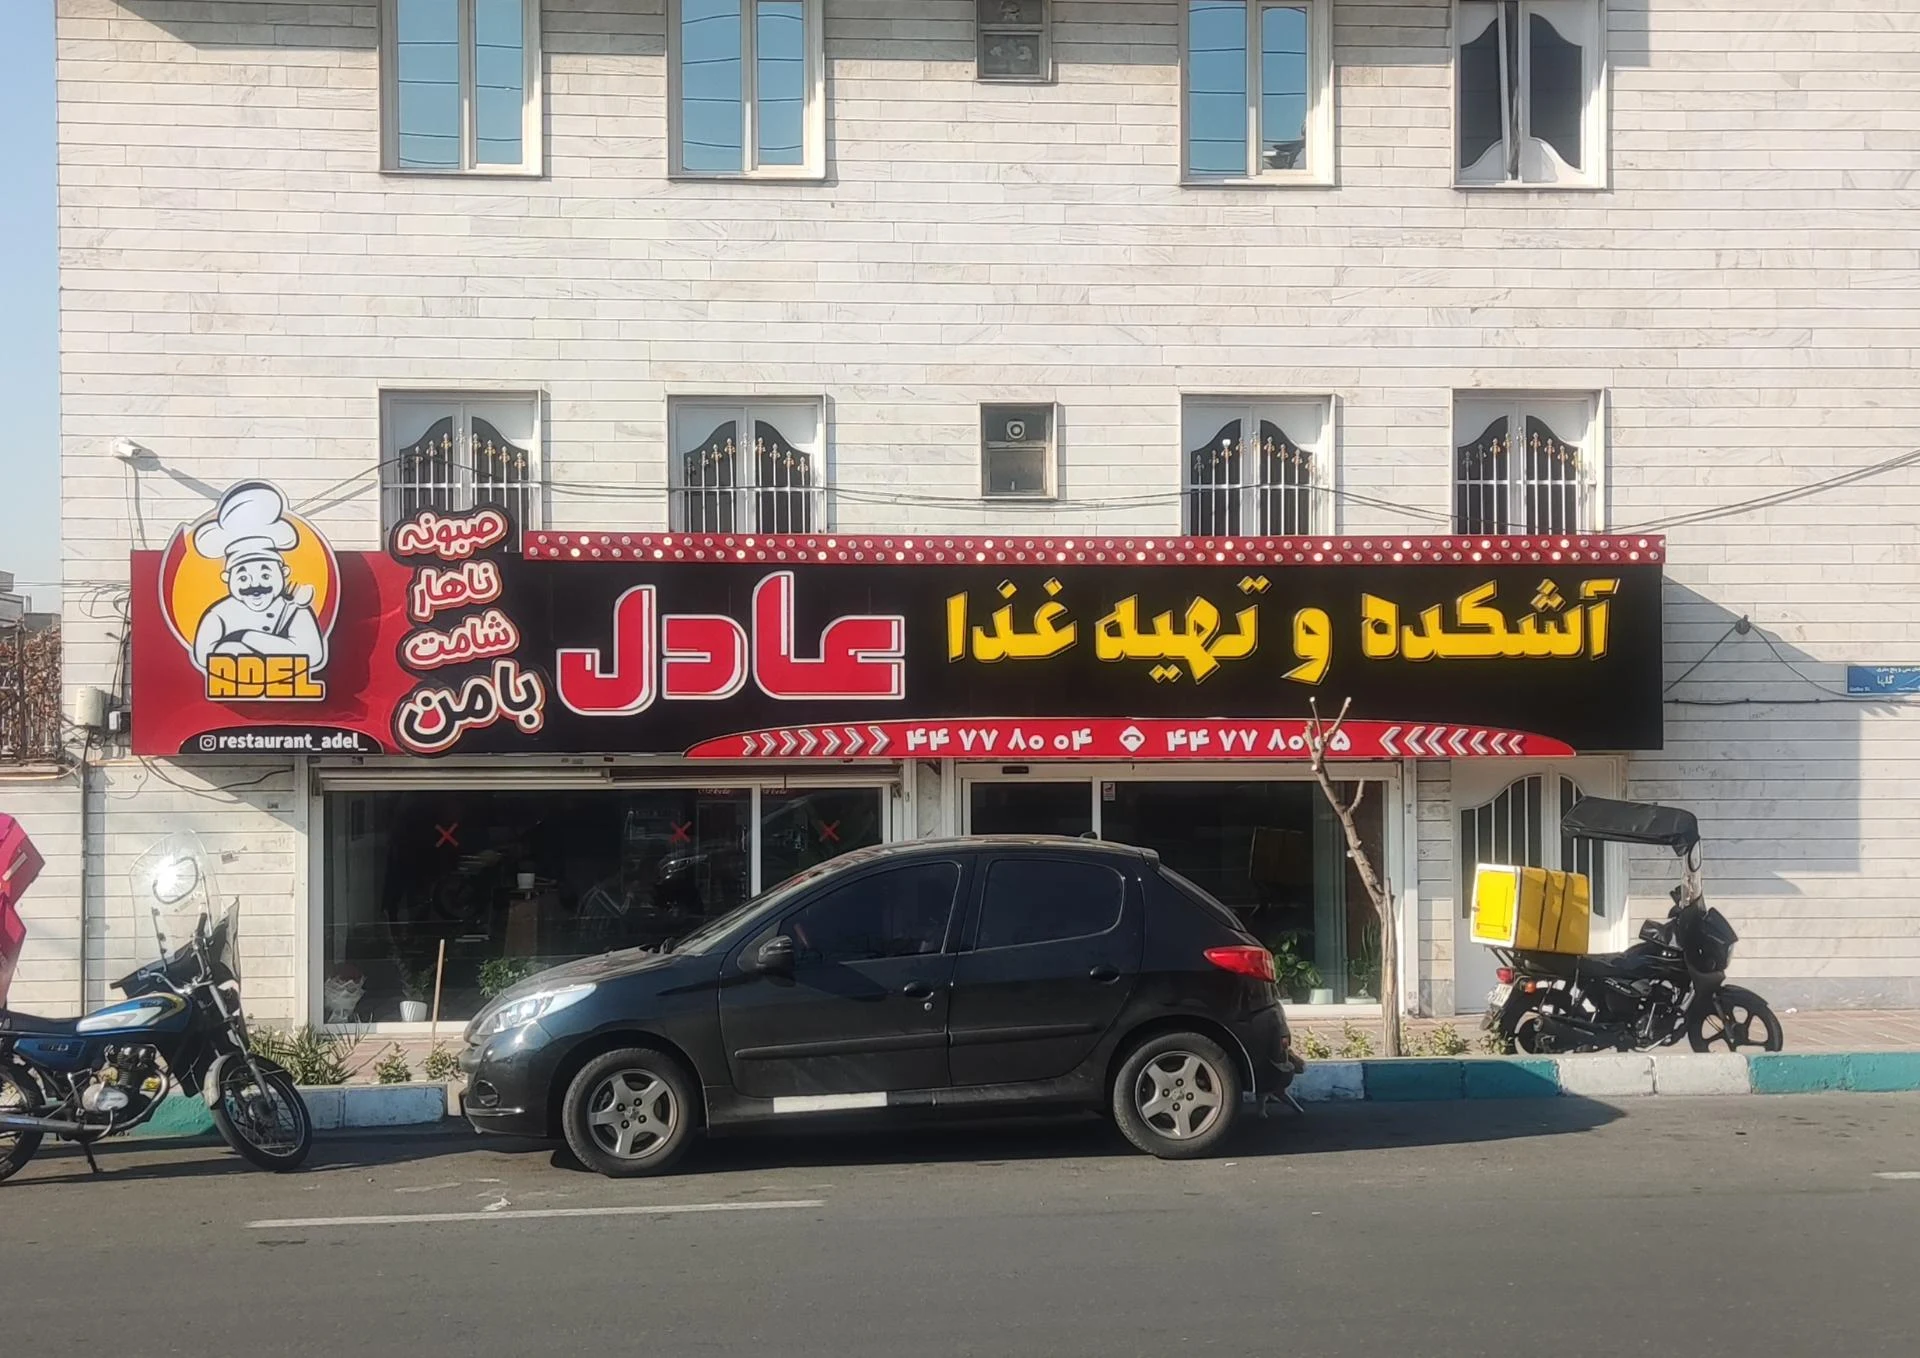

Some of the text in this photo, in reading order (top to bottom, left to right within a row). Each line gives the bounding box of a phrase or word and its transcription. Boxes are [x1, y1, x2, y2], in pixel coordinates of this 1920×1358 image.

[396, 512, 502, 557] صبونه
[412, 561, 500, 622] ناهار
[402, 612, 520, 668] شامت
[556, 571, 905, 716] عادل
[946, 574, 1622, 686] آشکده و تهیه غذا
[206, 655, 325, 699] ADEL
[219, 733, 368, 751] restaurant_adel_
